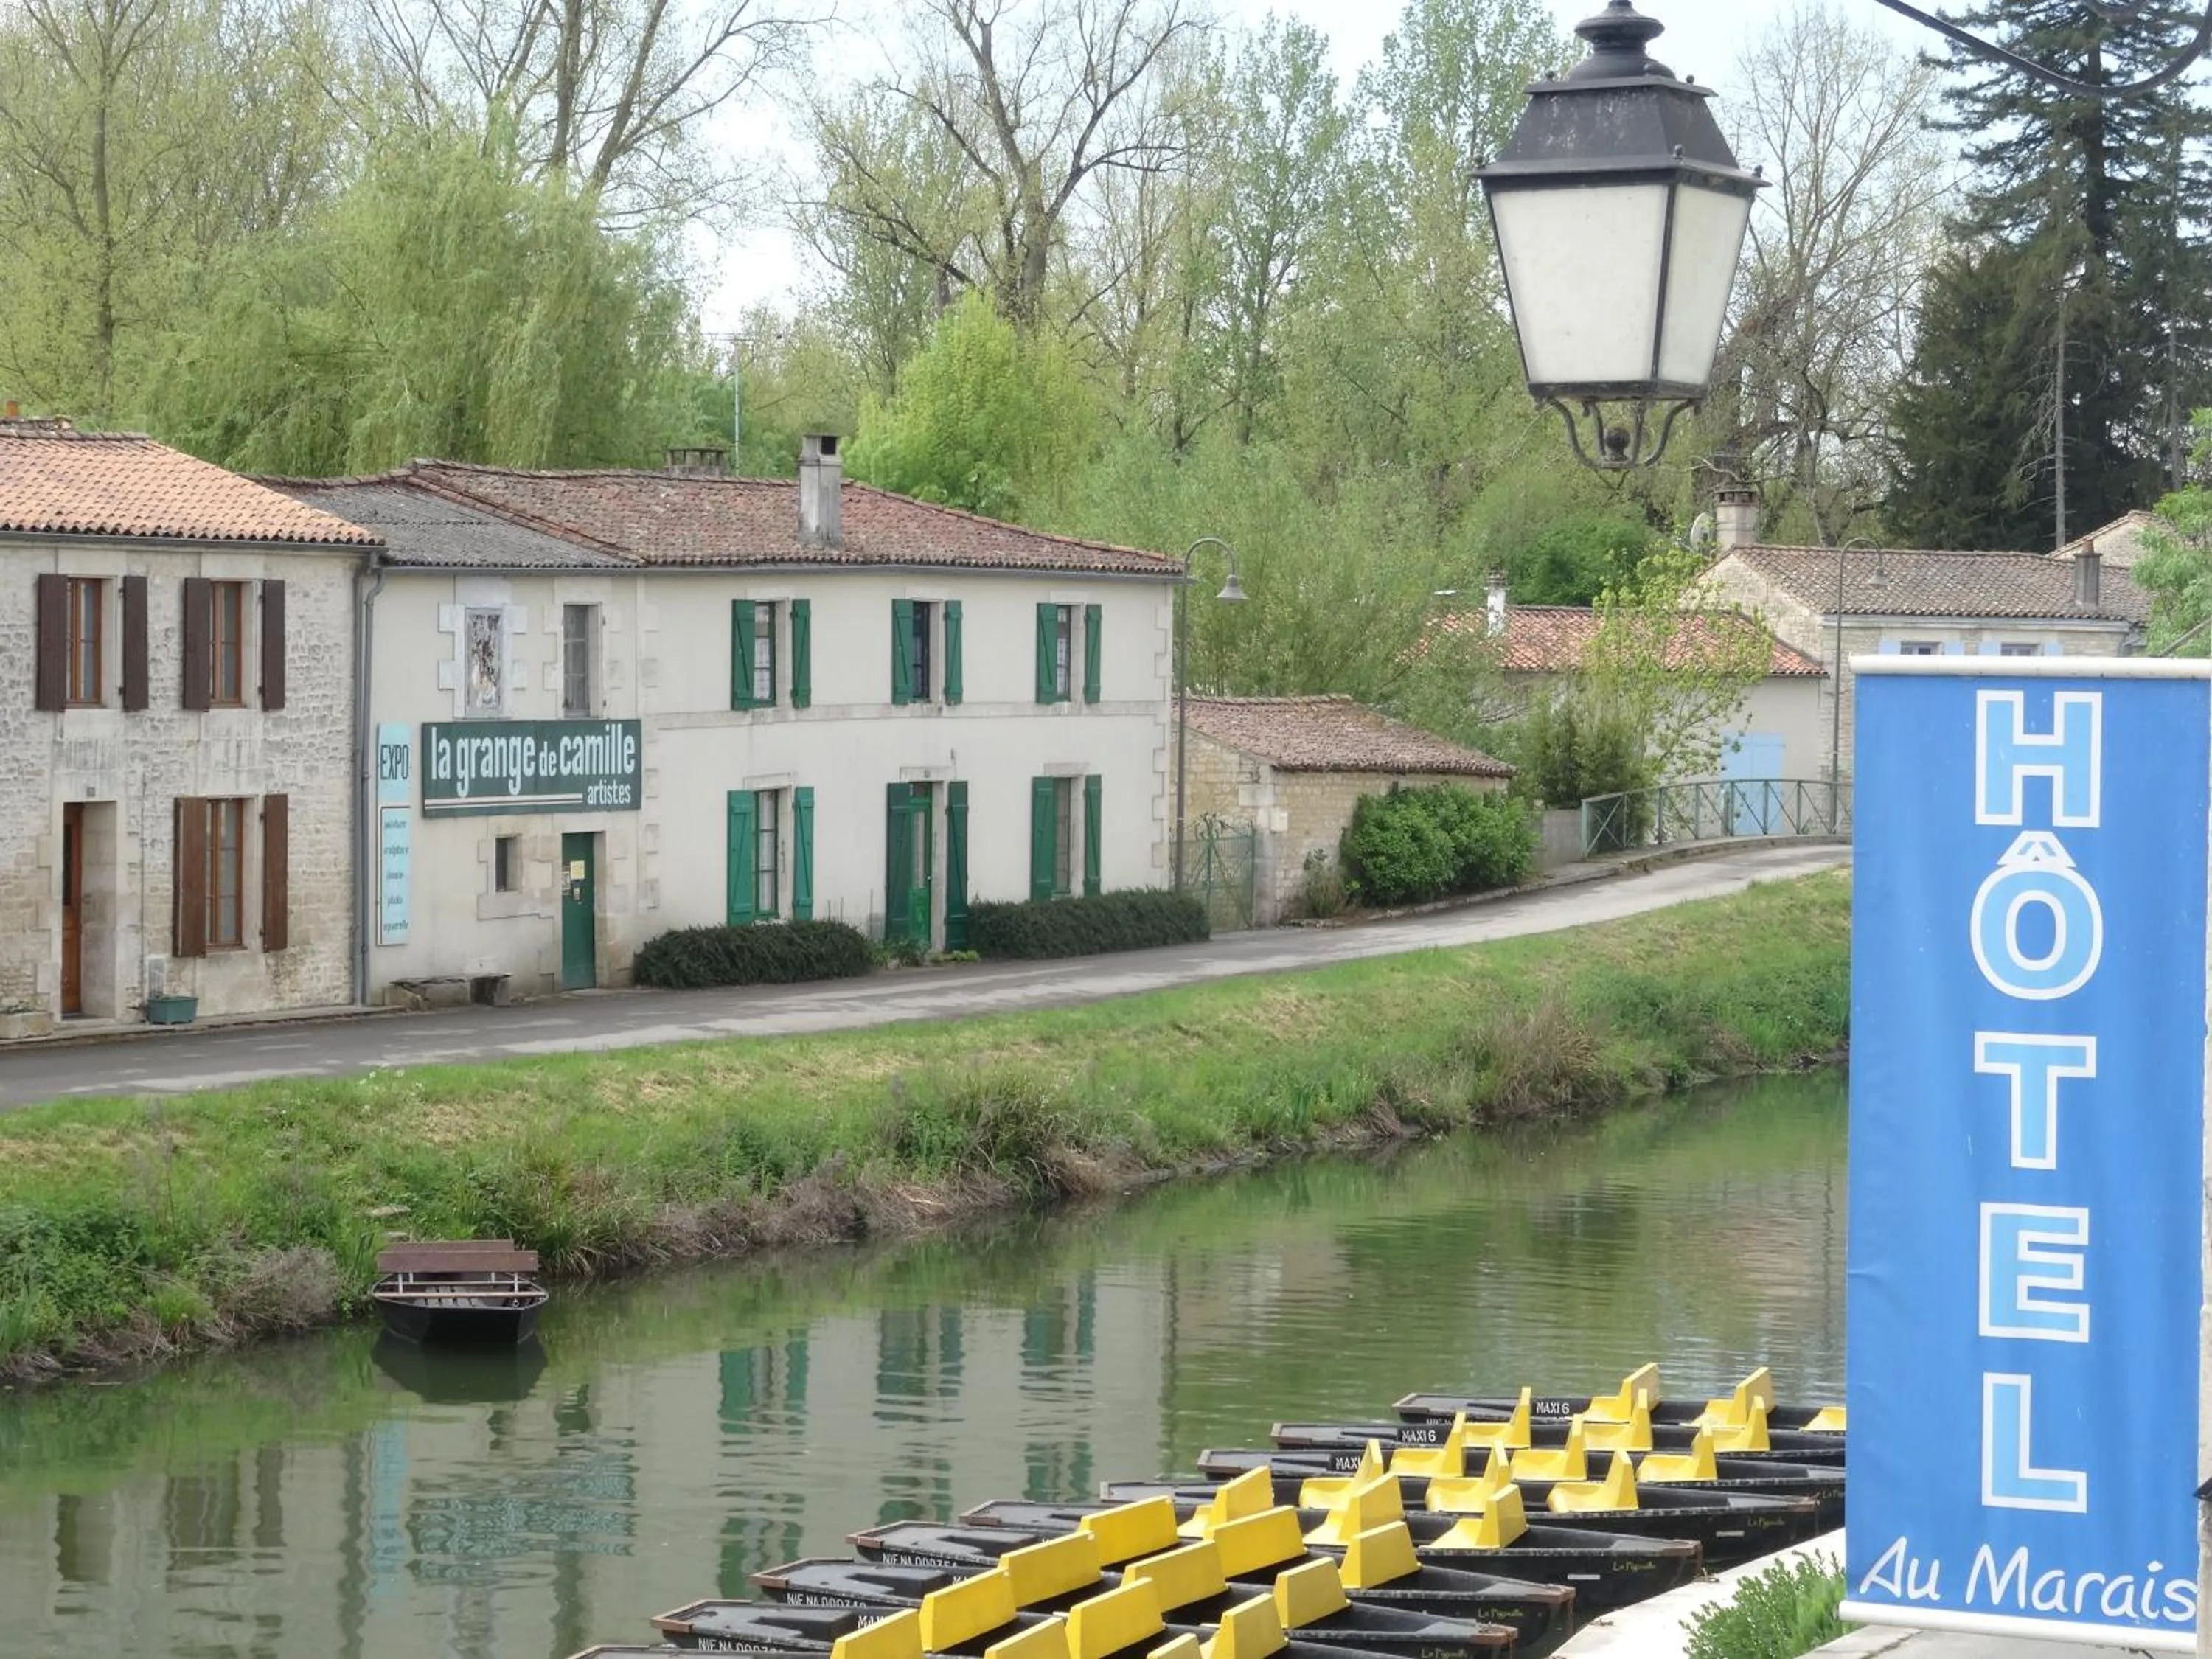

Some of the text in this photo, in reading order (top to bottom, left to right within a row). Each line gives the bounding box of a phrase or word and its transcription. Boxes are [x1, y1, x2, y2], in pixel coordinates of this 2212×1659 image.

[380, 744, 409, 780] EXPO
[431, 723, 635, 798] la grange de camille
[588, 779, 631, 805] artistes
[1970, 690, 2102, 1514] HÔTEL
[1536, 1402, 1570, 1415] MAXI 6
[1402, 1430, 1436, 1443] MAXI 6
[1858, 1536, 2198, 1622] Au Marais
